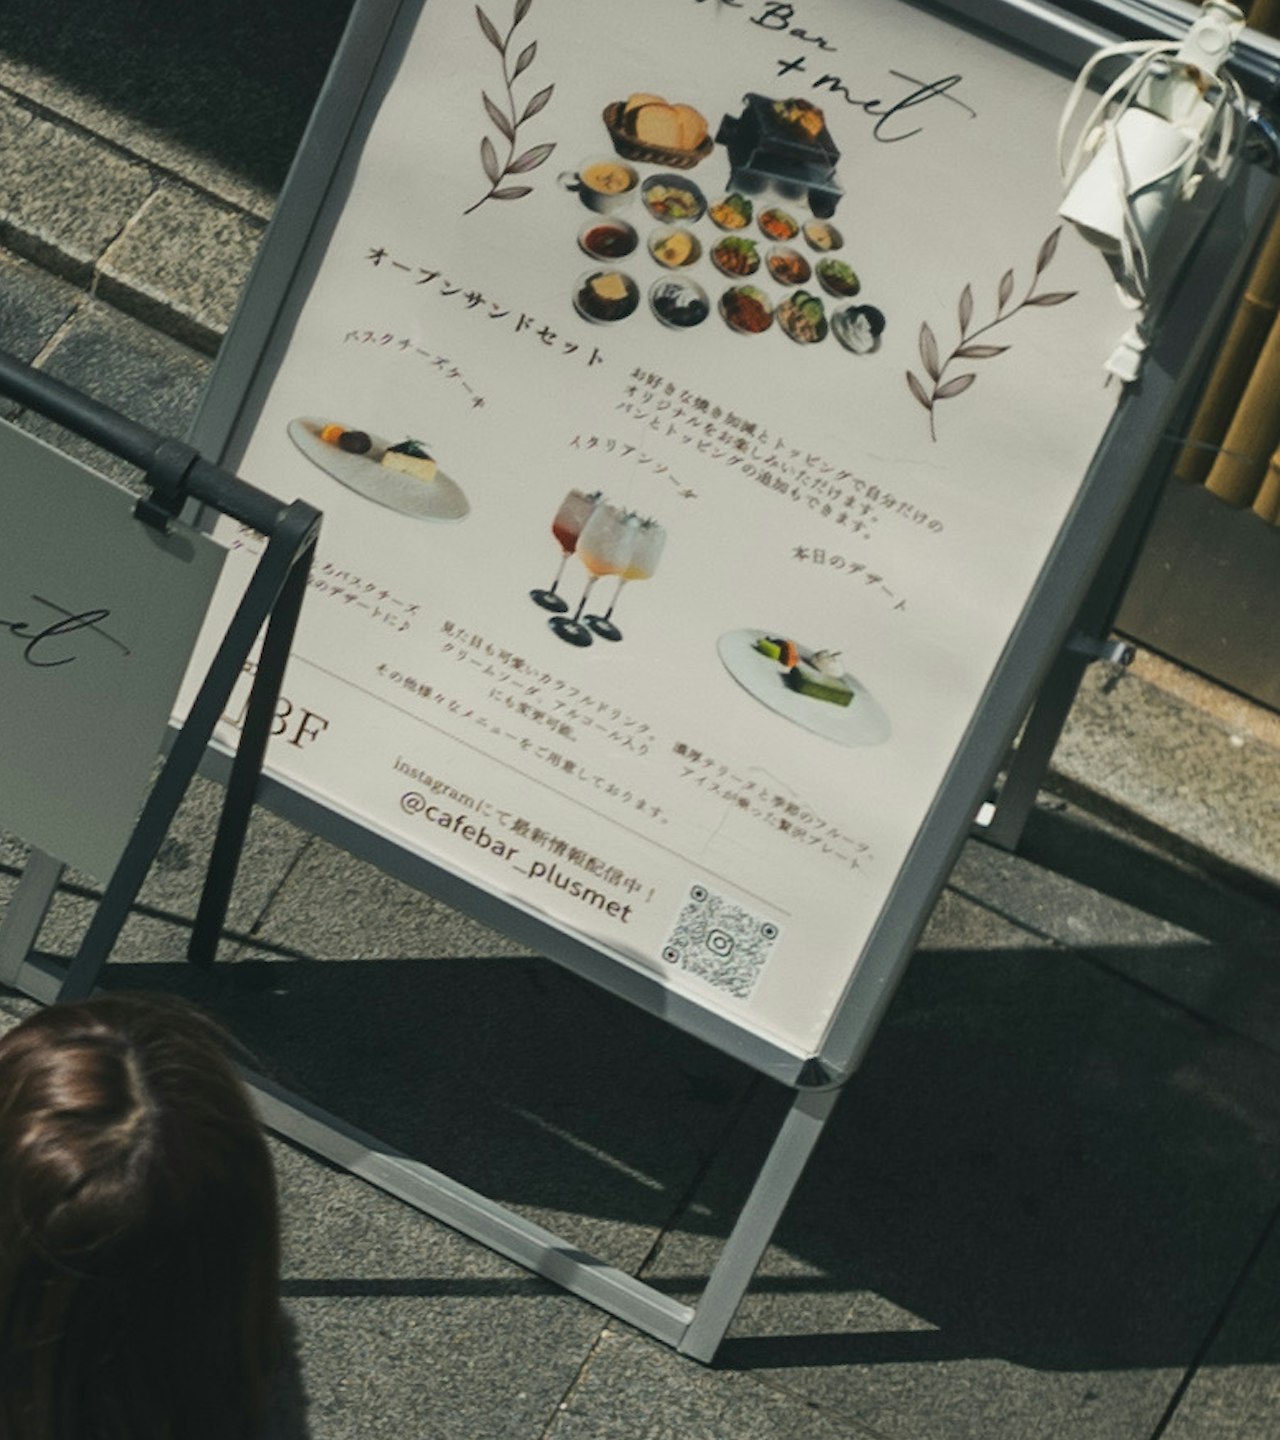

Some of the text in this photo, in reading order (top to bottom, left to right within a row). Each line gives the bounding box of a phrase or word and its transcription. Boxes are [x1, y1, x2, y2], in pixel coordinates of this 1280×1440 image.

[812, 65, 980, 148] met
[362, 241, 607, 371] オープンサンドセット
[790, 543, 909, 616] 本日のデザート
[396, 783, 636, 927] @cafebar_plusmet
